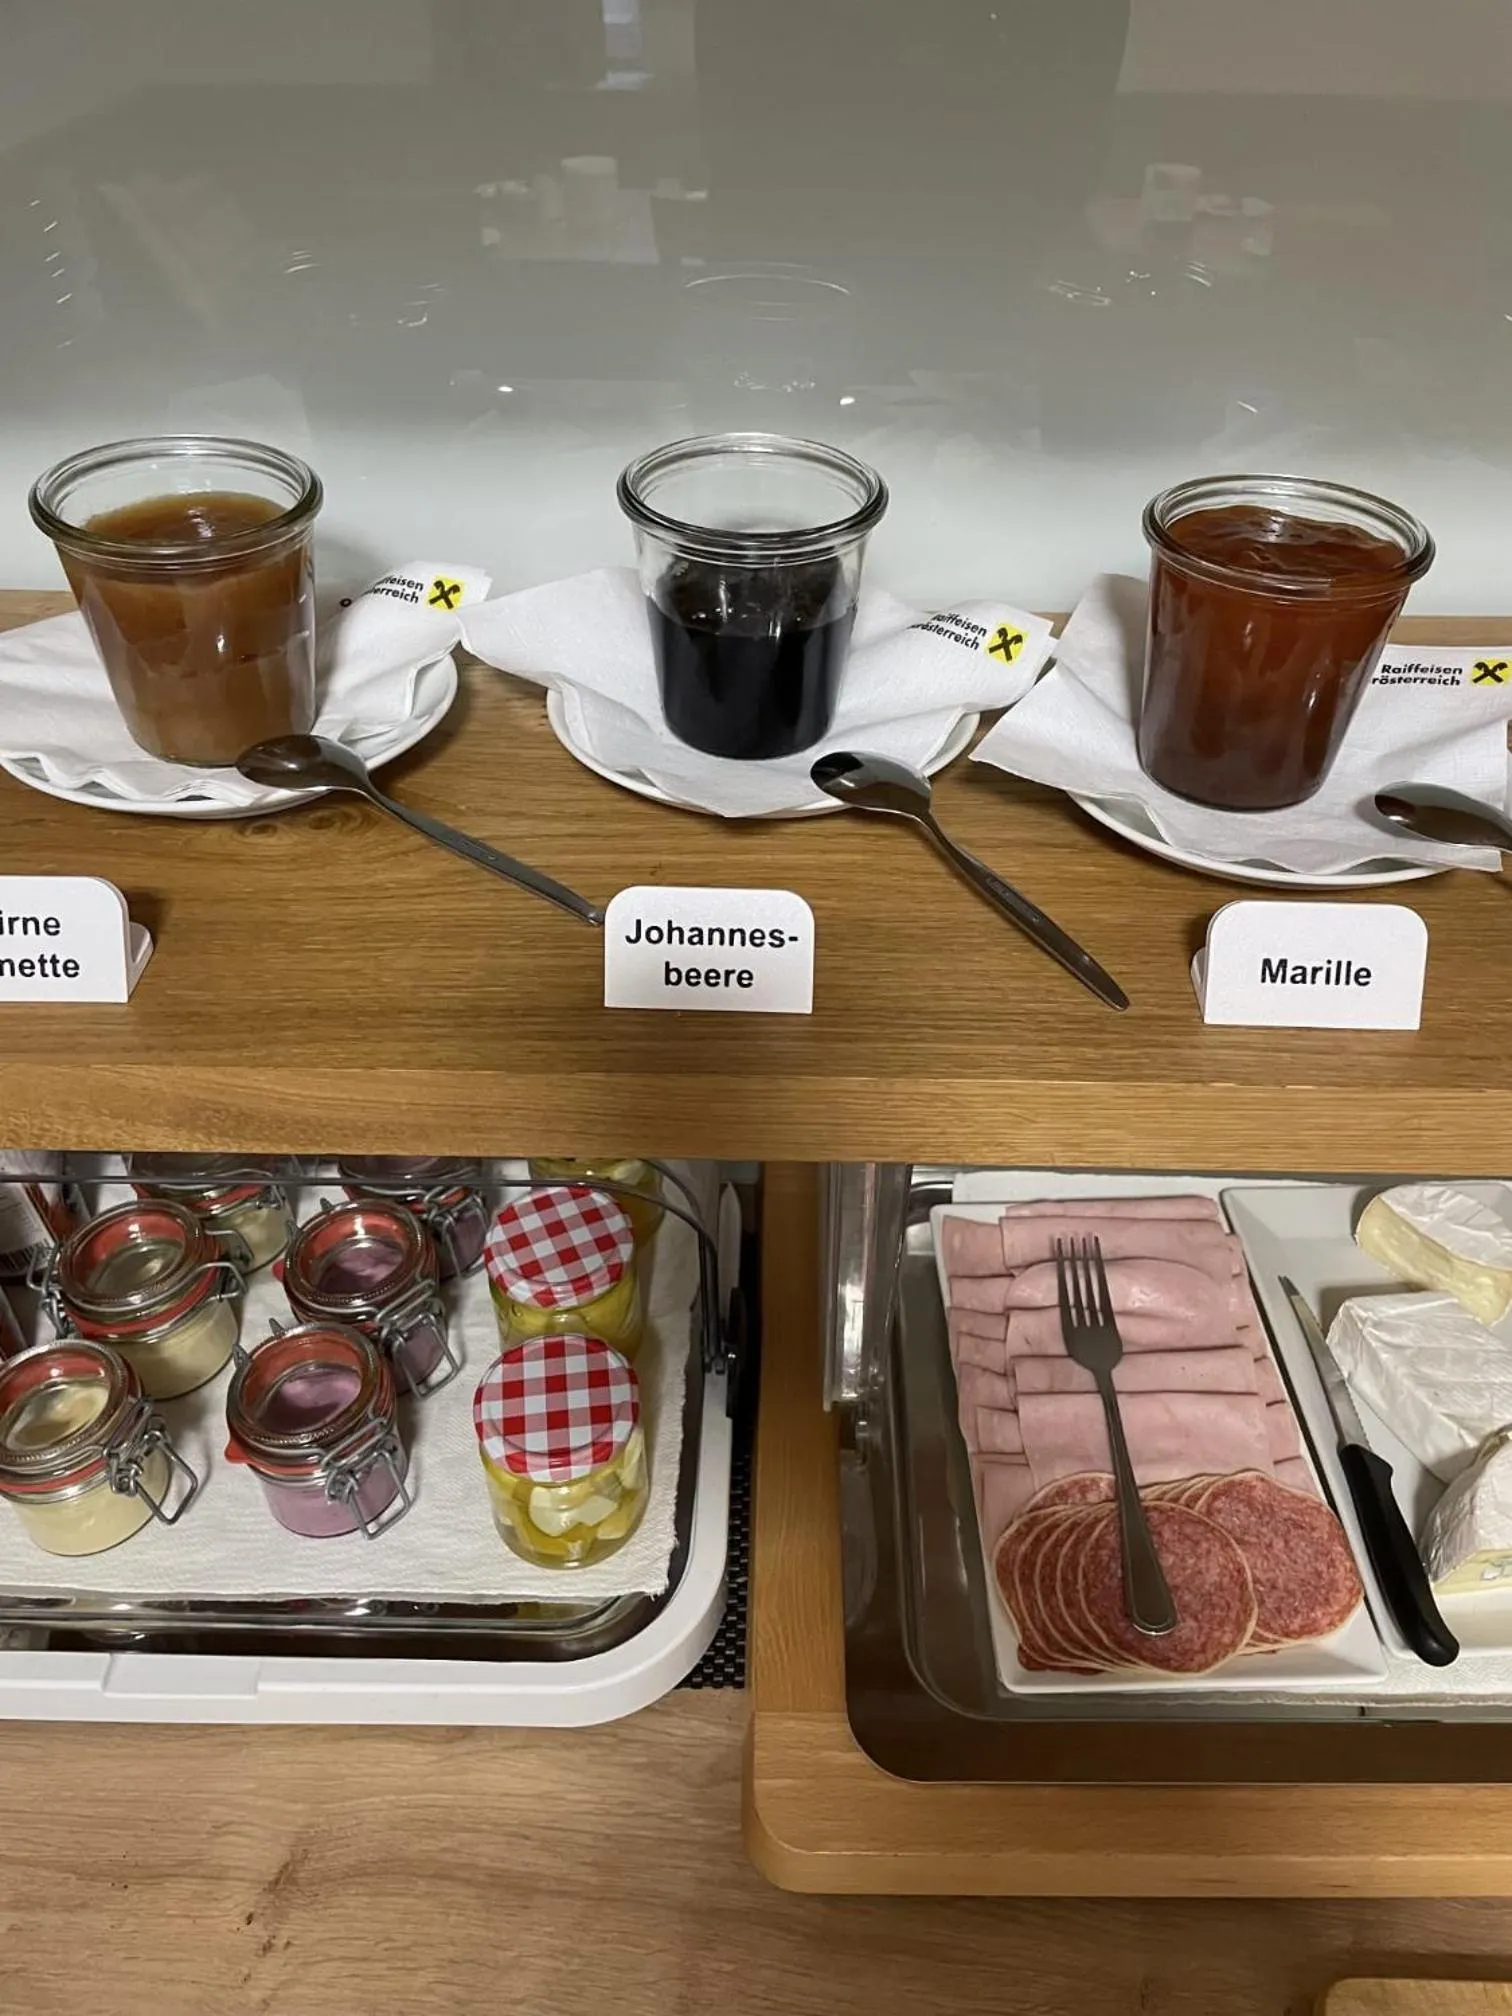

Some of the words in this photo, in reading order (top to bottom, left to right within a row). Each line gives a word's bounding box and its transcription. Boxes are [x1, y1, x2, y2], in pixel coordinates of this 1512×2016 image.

[1371, 674, 1461, 687] rösterreich
[1381, 663, 1463, 676] Raiffeisen
[0, 910, 61, 936] irne
[625, 918, 799, 949] Johannes-
[664, 961, 754, 989] beere
[1260, 957, 1373, 988] Marille
